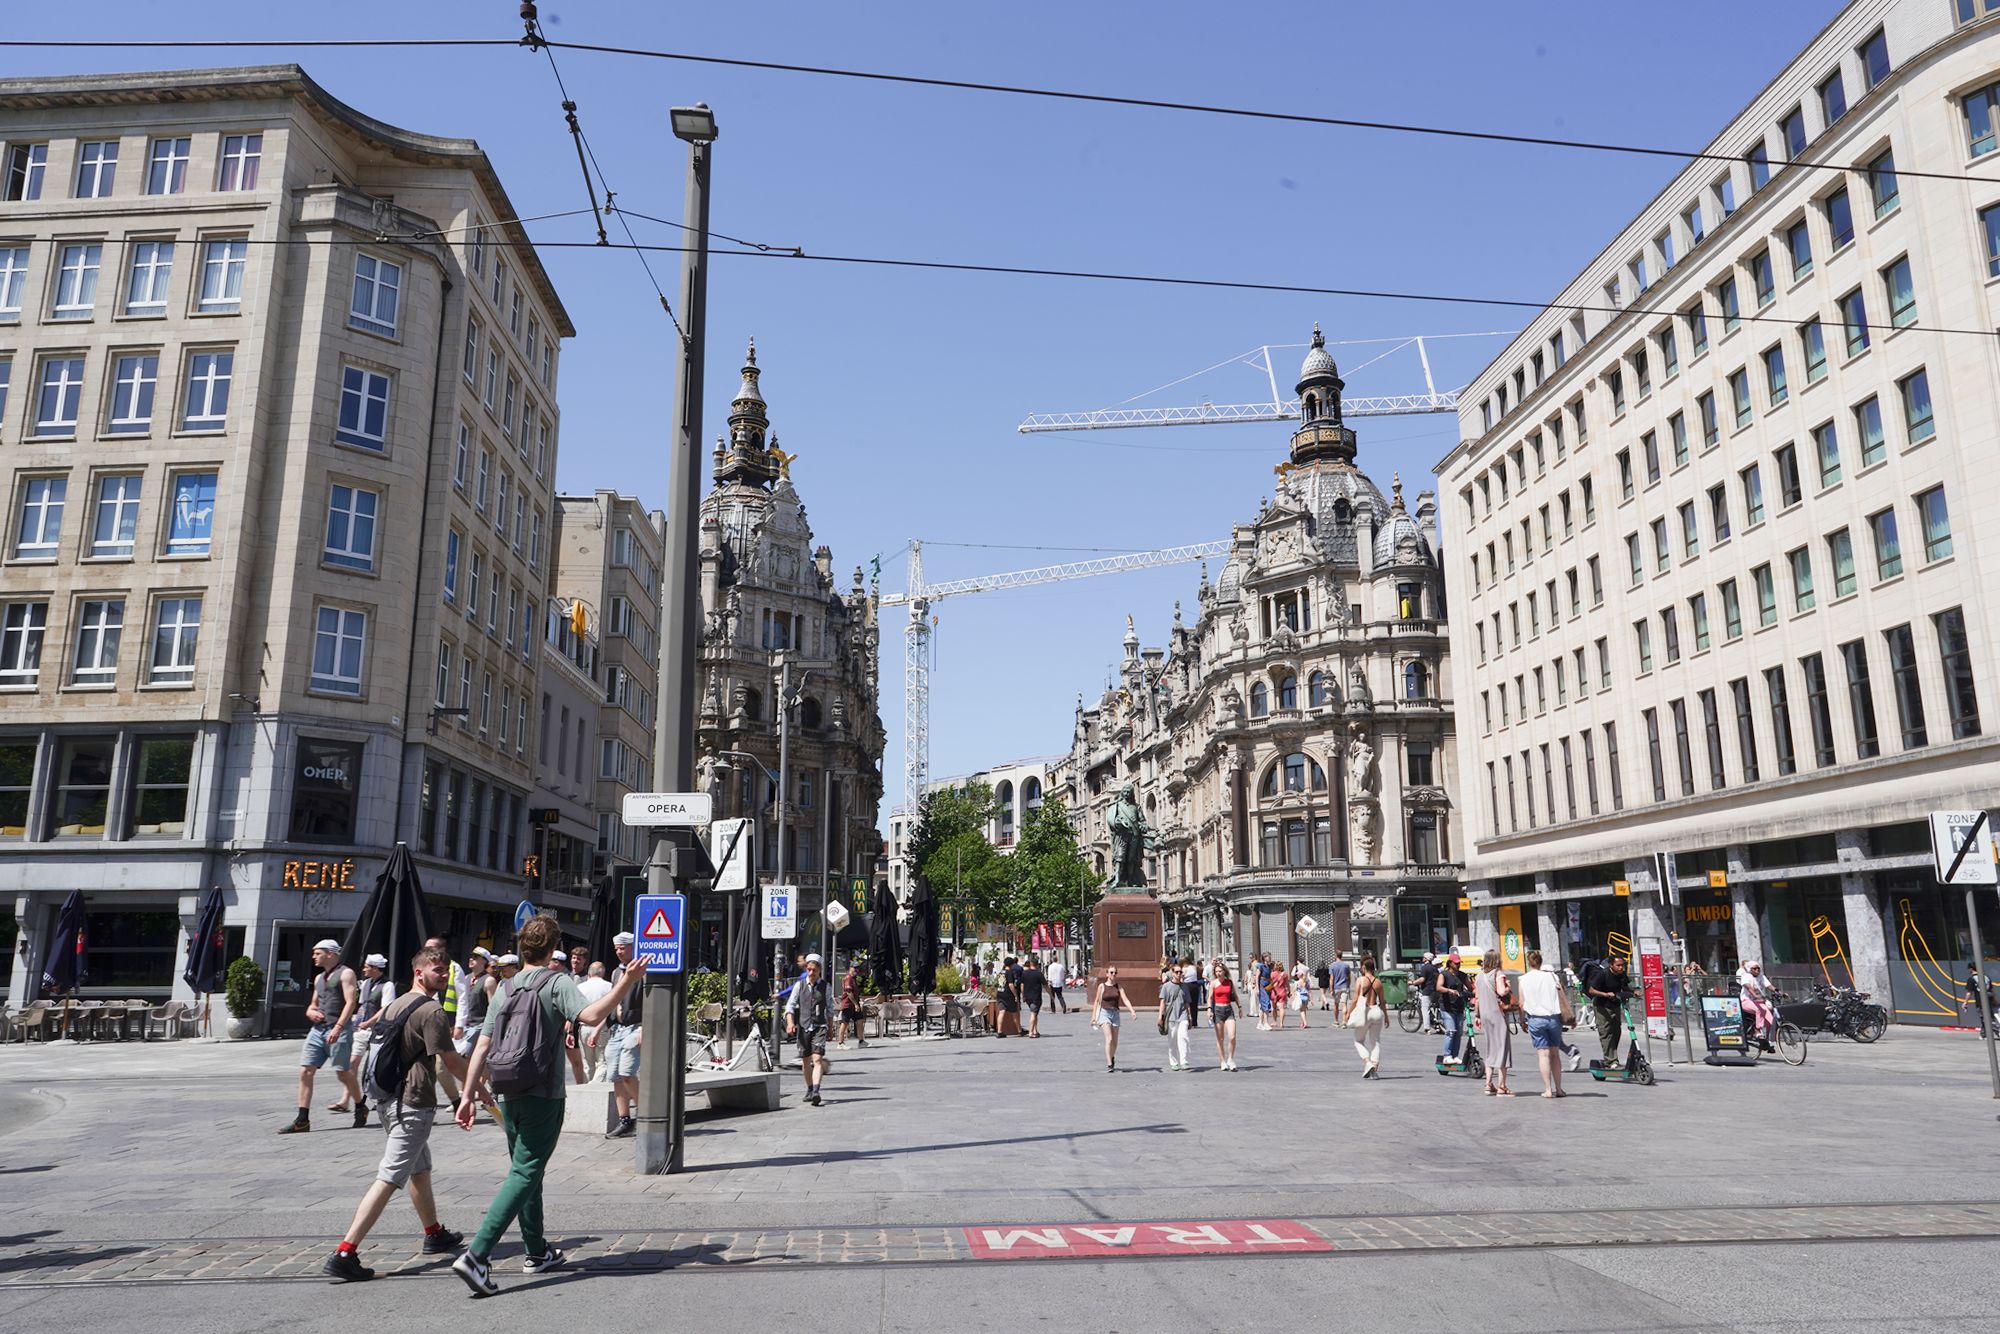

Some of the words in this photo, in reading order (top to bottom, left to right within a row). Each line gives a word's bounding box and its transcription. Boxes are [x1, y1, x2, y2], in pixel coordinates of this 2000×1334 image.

[304, 766, 348, 780] OMER.
[648, 804, 686, 813] OPERA
[1947, 815, 1976, 823] ZONE
[720, 823, 738, 832] ZONE
[283, 857, 355, 889] RENÉ
[1687, 905, 1731, 921] JUMBO
[982, 1224, 1308, 1250] TRAM
